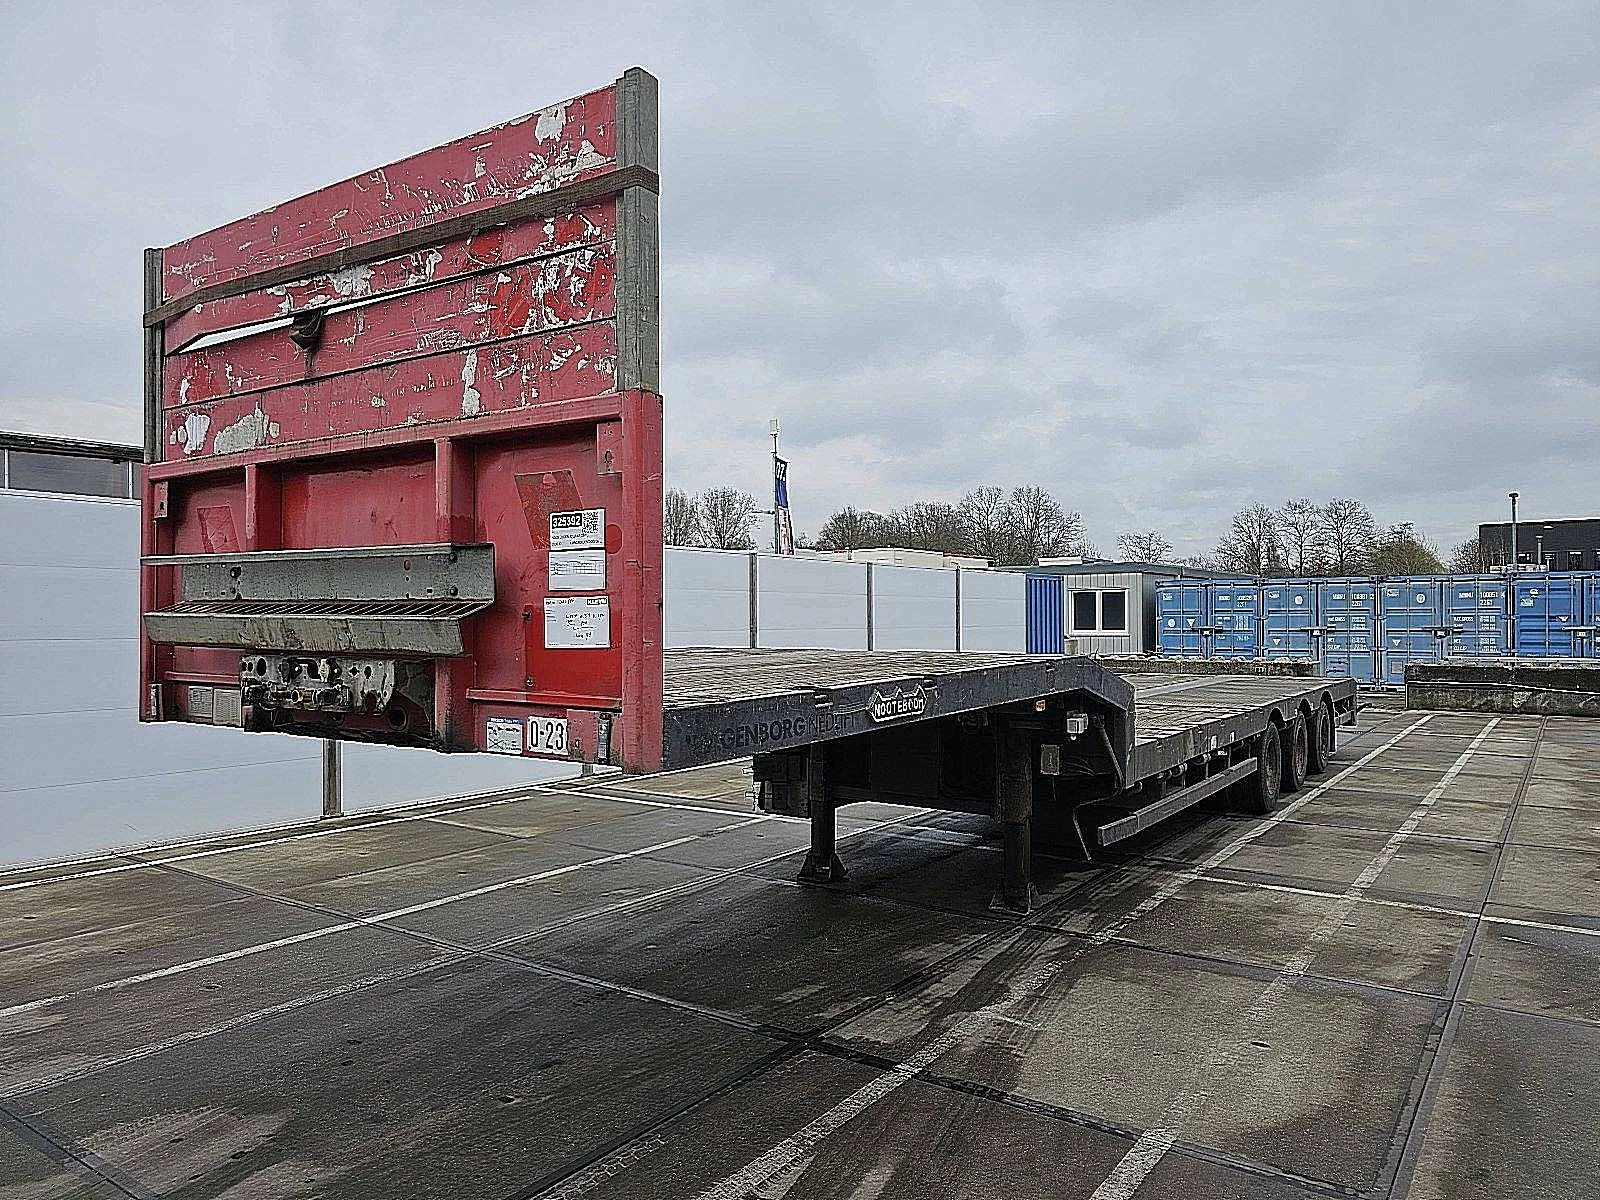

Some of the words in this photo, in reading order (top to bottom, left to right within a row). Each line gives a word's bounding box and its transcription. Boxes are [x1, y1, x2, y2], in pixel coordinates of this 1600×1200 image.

[552, 515, 581, 528] 325392
[874, 696, 925, 718] NOOTEBOOM
[686, 716, 806, 752] GENBORG
